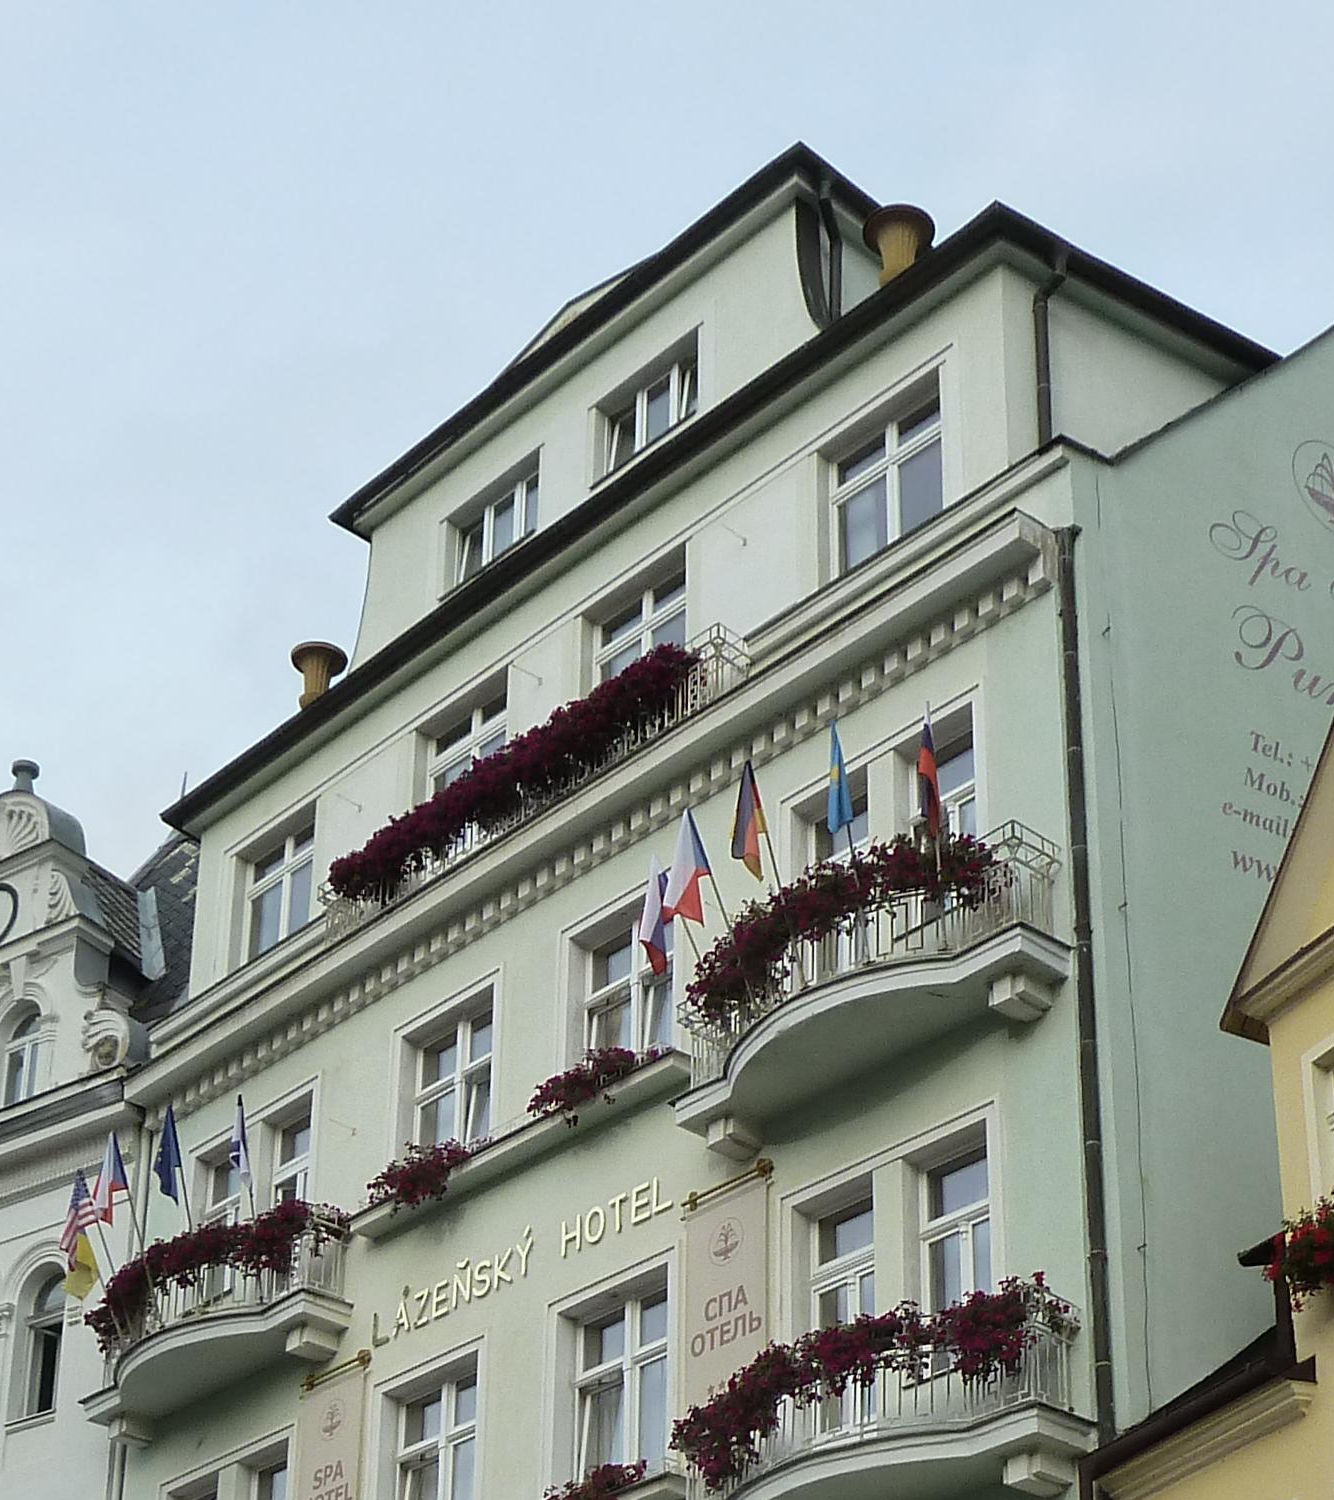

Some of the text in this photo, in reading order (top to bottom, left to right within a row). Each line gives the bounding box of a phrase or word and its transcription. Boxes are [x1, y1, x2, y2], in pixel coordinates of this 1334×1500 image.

[1209, 510, 1313, 591] Spa
[1250, 730, 1294, 767] Tel.:
[372, 1176, 673, 1348] LÁZEŇSKÝ HOTEL
[704, 1285, 749, 1323] СПА
[691, 1311, 763, 1358] ОТЕЛЬ
[312, 1460, 344, 1491] SPA
